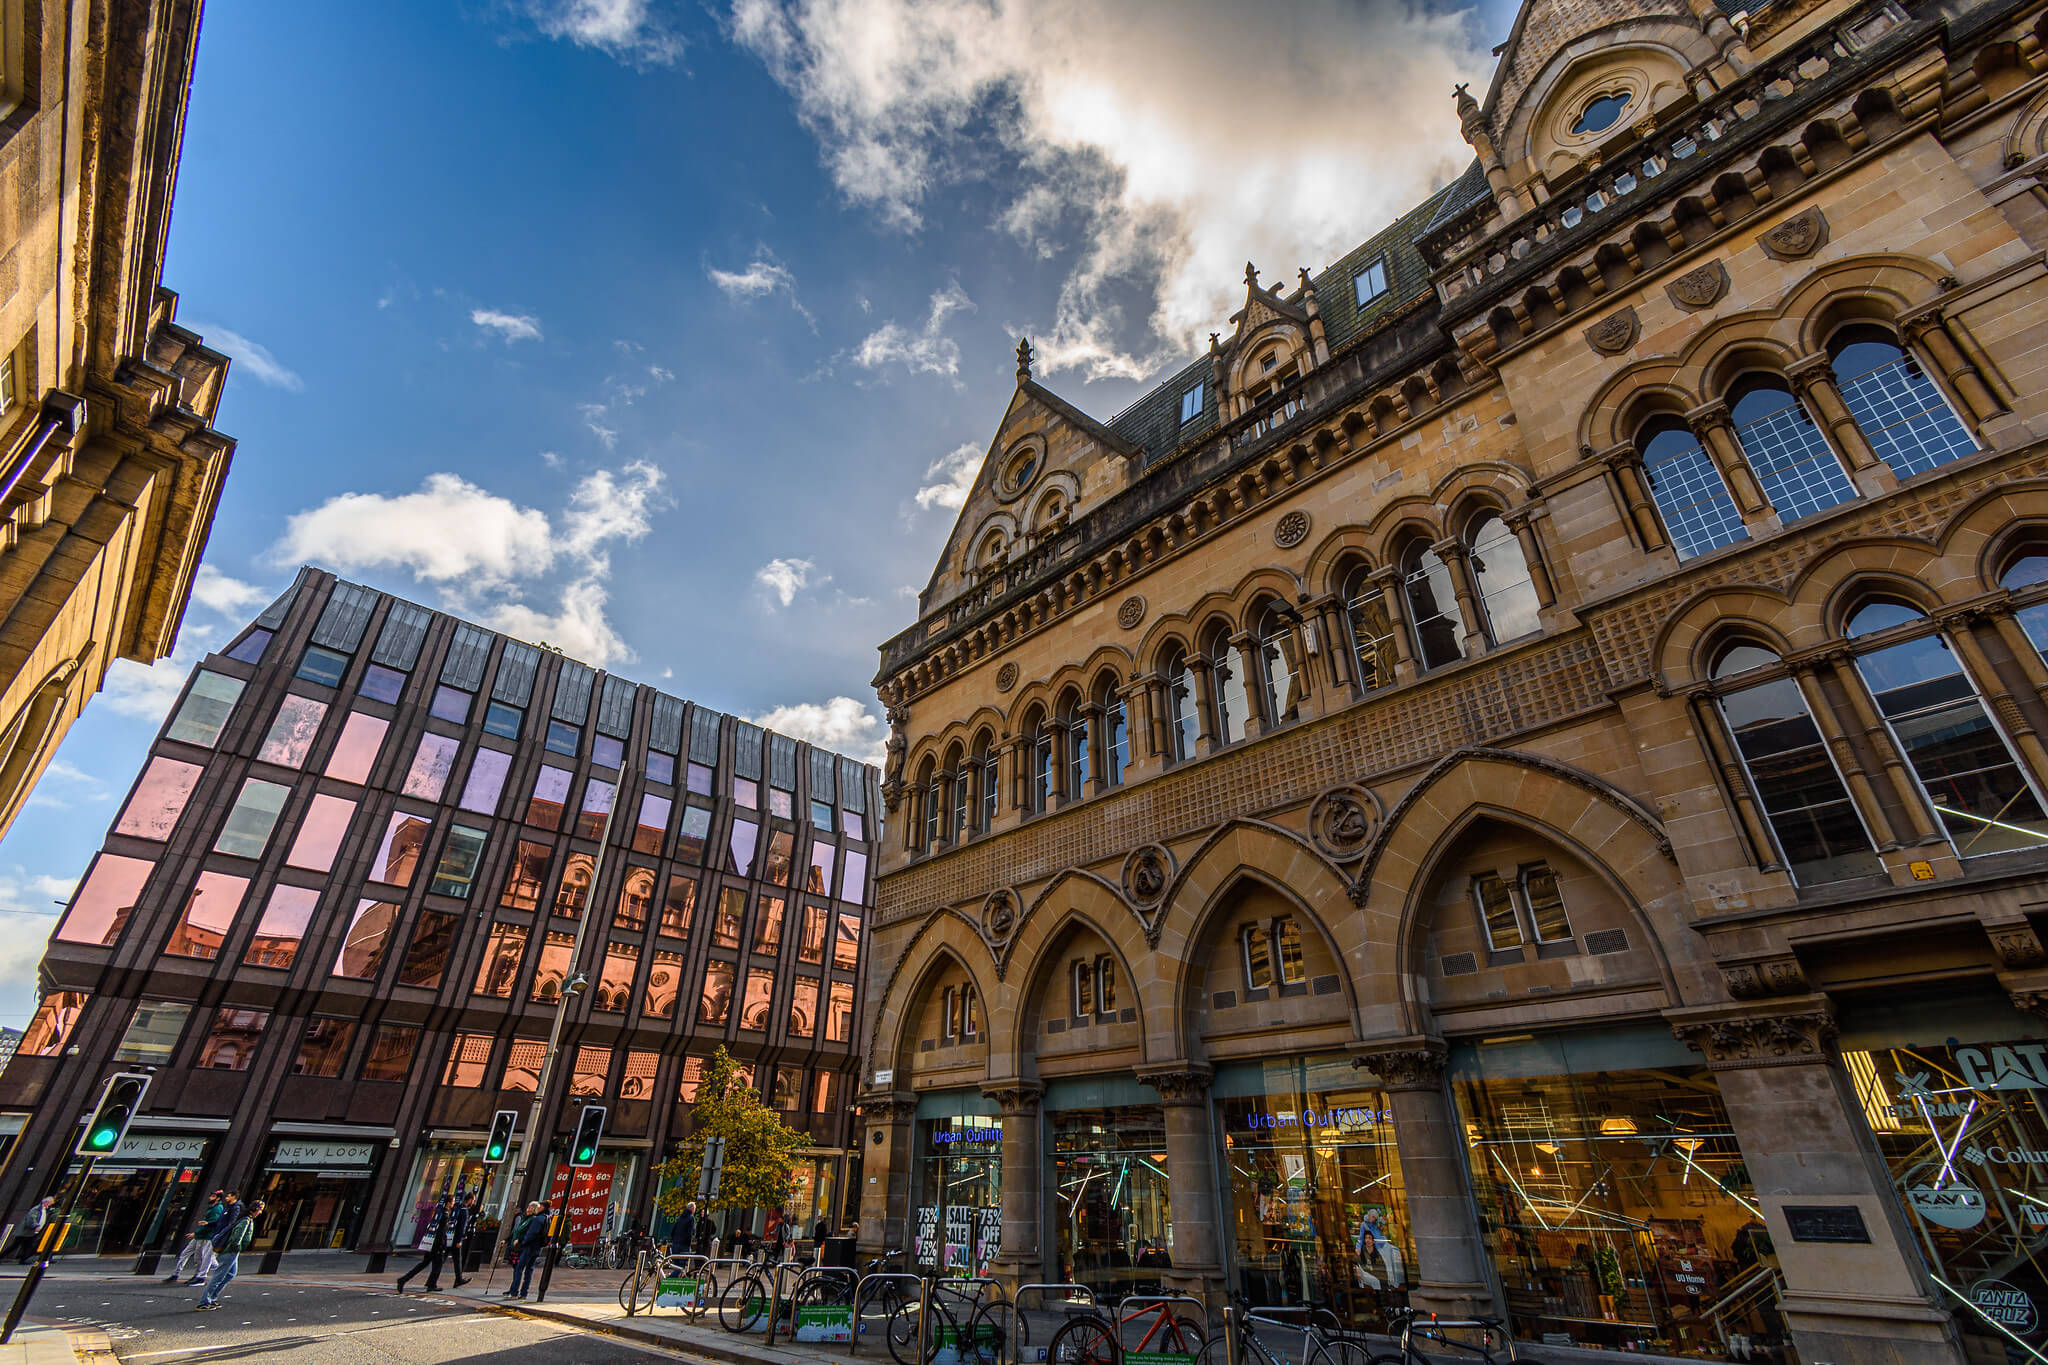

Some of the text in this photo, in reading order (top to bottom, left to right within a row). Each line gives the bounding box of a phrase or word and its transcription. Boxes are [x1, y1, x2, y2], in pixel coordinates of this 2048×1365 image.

[1956, 1044, 2048, 1090] CAT
[1247, 1107, 1394, 1129] Urban Outfitters
[934, 1127, 1003, 1143] Urban Outfitte
[148, 1141, 200, 1151] LOOK
[280, 1147, 369, 1157] NEW LOOK
[551, 1188, 609, 1200] SAL SALE SALE
[918, 1207, 938, 1223] 75%
[980, 1208, 1001, 1225] 75%
[583, 1222, 601, 1234] SALE
[919, 1223, 936, 1239] OFF
[946, 1225, 967, 1244] SALE
[983, 1225, 1000, 1242] OFF
[917, 1240, 937, 1257] 75%
[951, 1247, 970, 1267] SAL
[979, 1243, 1001, 1260] 75%
[1975, 1289, 2029, 1307] SANTA
[1983, 1306, 2030, 1325] CRUZ
[860, 1324, 866, 1332] P
